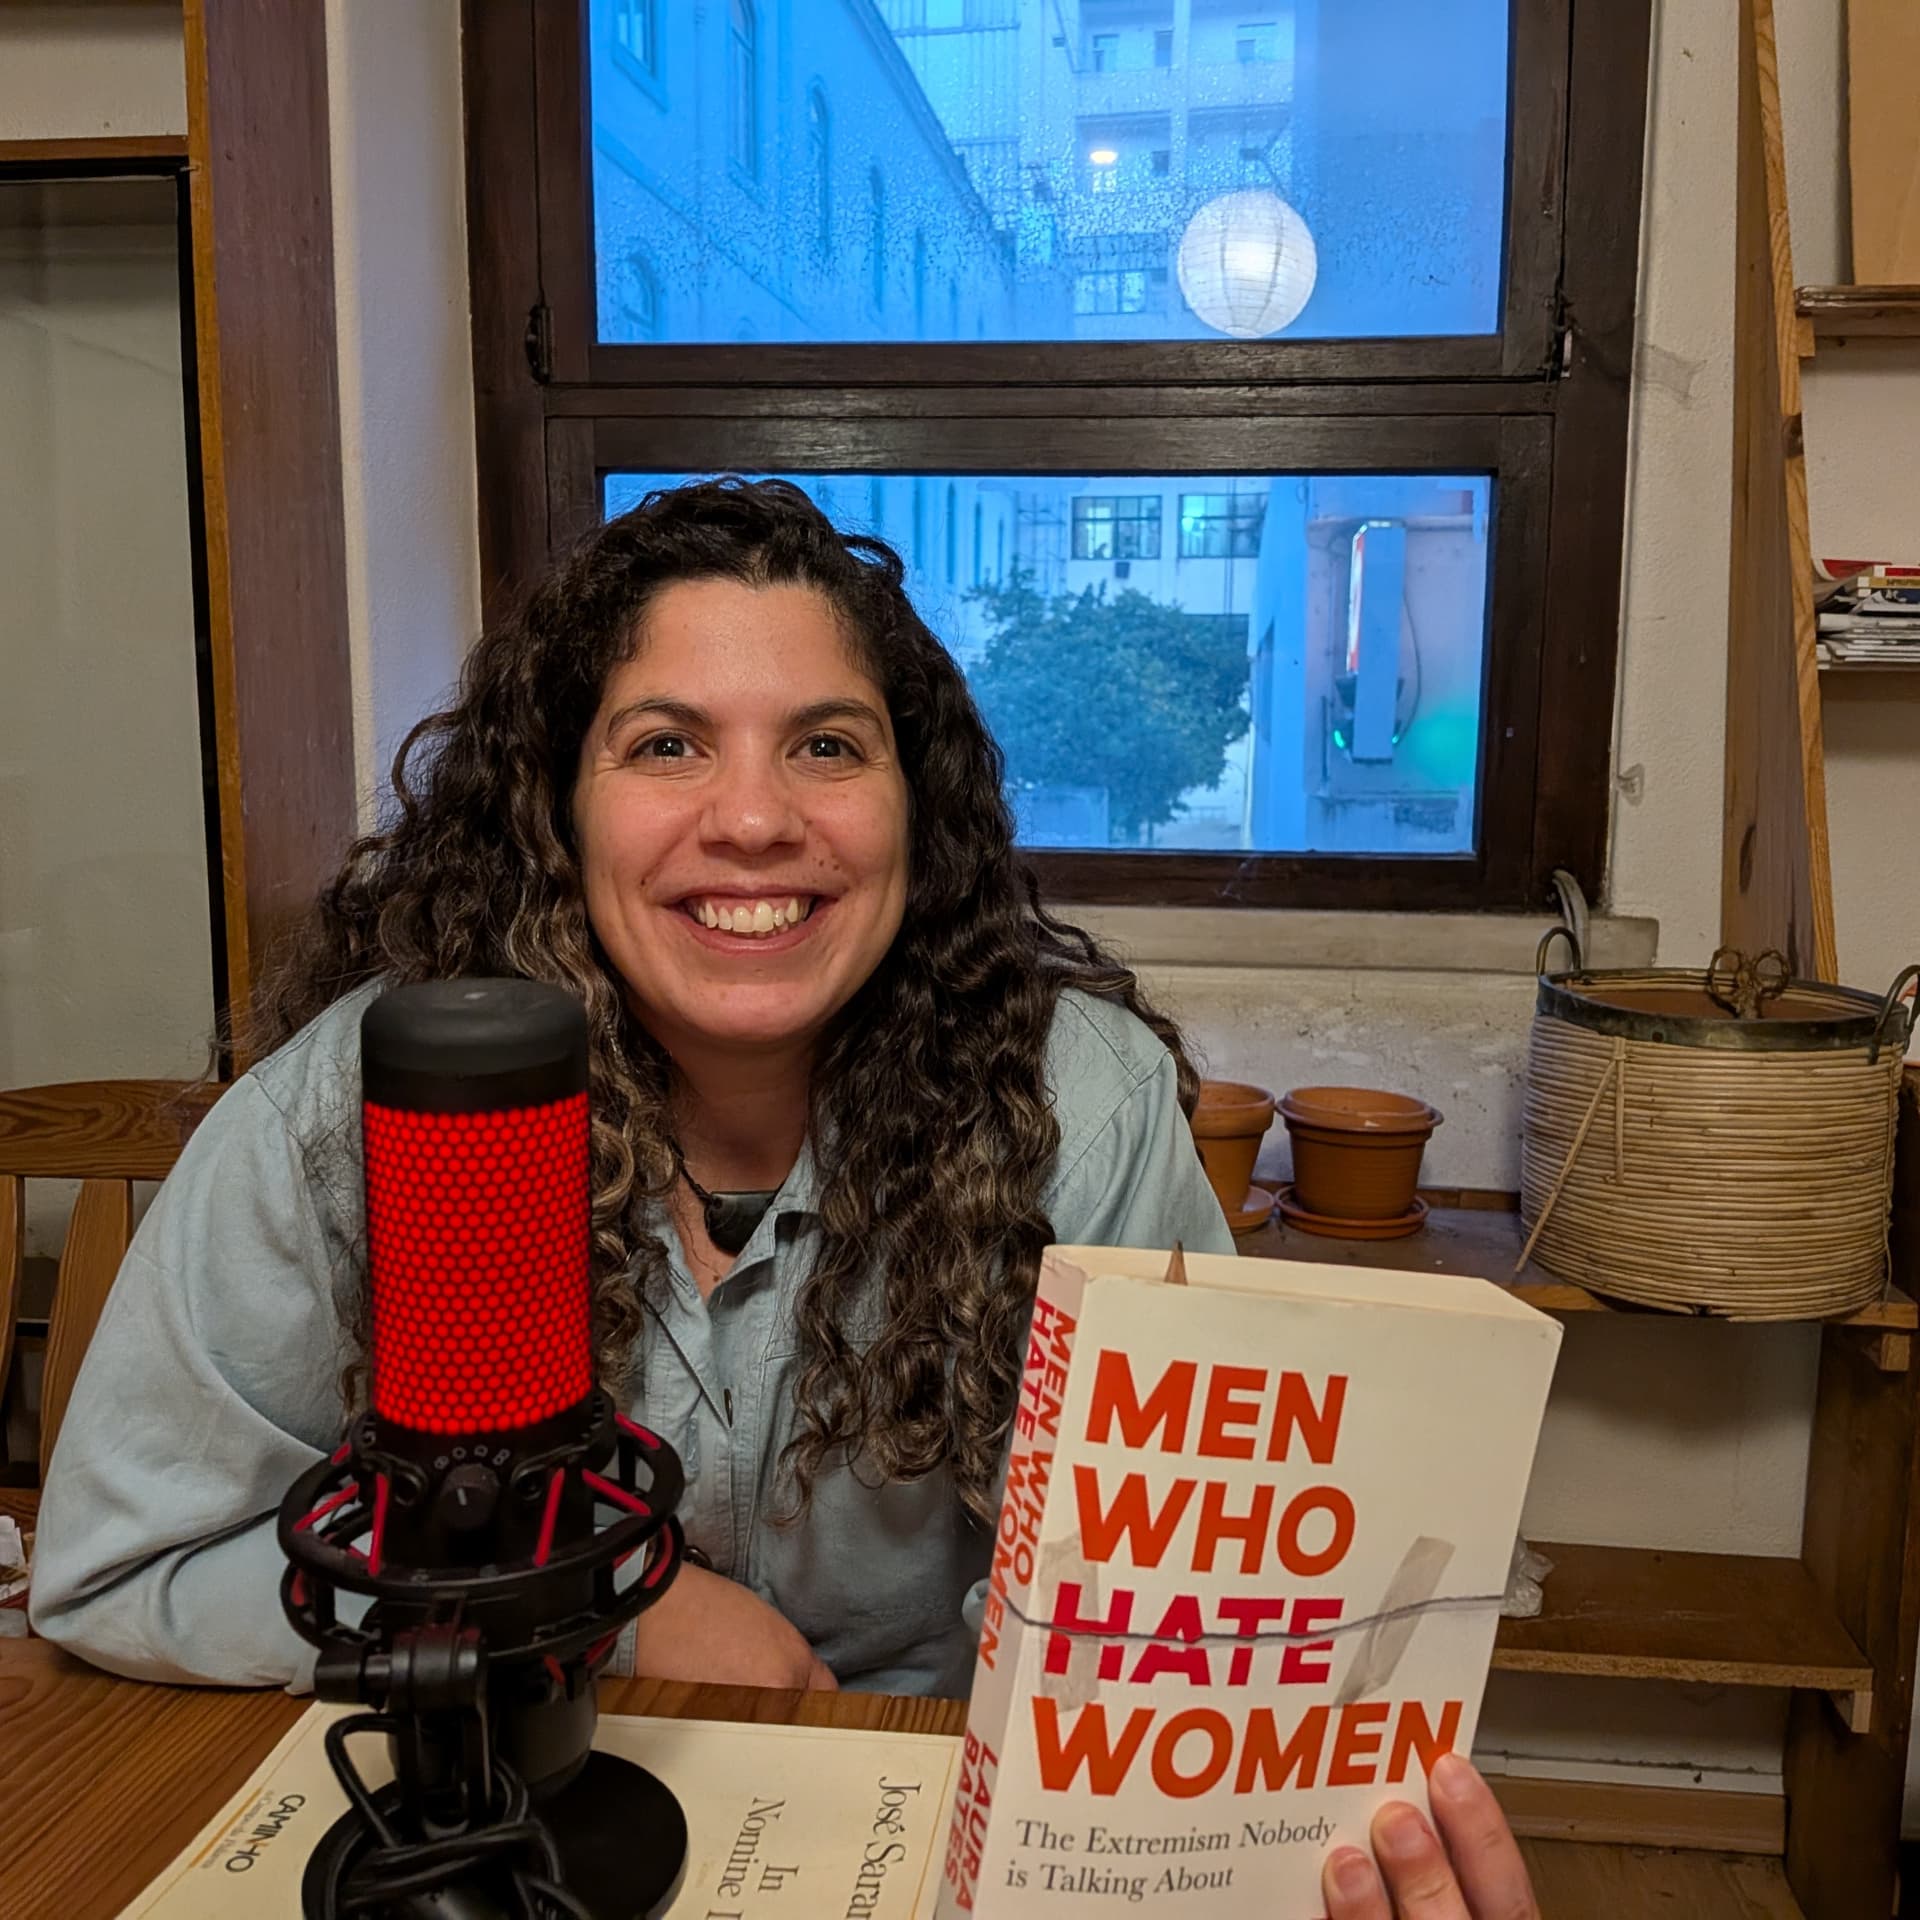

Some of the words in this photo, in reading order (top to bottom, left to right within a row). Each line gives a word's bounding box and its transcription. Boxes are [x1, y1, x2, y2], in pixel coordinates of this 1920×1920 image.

[1015, 1296, 1055, 1441] HATE
[1038, 1310, 1077, 1438] MEN
[1085, 1349, 1349, 1465] MEN
[979, 1454, 1030, 1671] WOMEN
[1014, 1451, 1053, 1586] WHO
[1073, 1464, 1356, 1577] WHO
[1044, 1581, 1345, 1686] HATE
[1032, 1696, 1463, 1799] WOMEN
[225, 1794, 306, 1873] CAMINHO
[717, 1797, 786, 1898] Nomine
[872, 1776, 922, 1835] José
[945, 1729, 980, 1886] BATES
[955, 1742, 998, 1912] LAURA
[1015, 1819, 1075, 1852] The
[1085, 1826, 1231, 1855] Extremism
[1238, 1816, 1336, 1847] Nobody
[757, 1864, 799, 1893] In
[846, 1841, 906, 1920] Sara
[1005, 1860, 1028, 1888] is
[1039, 1863, 1148, 1902] Talking
[1153, 1866, 1233, 1893] About
